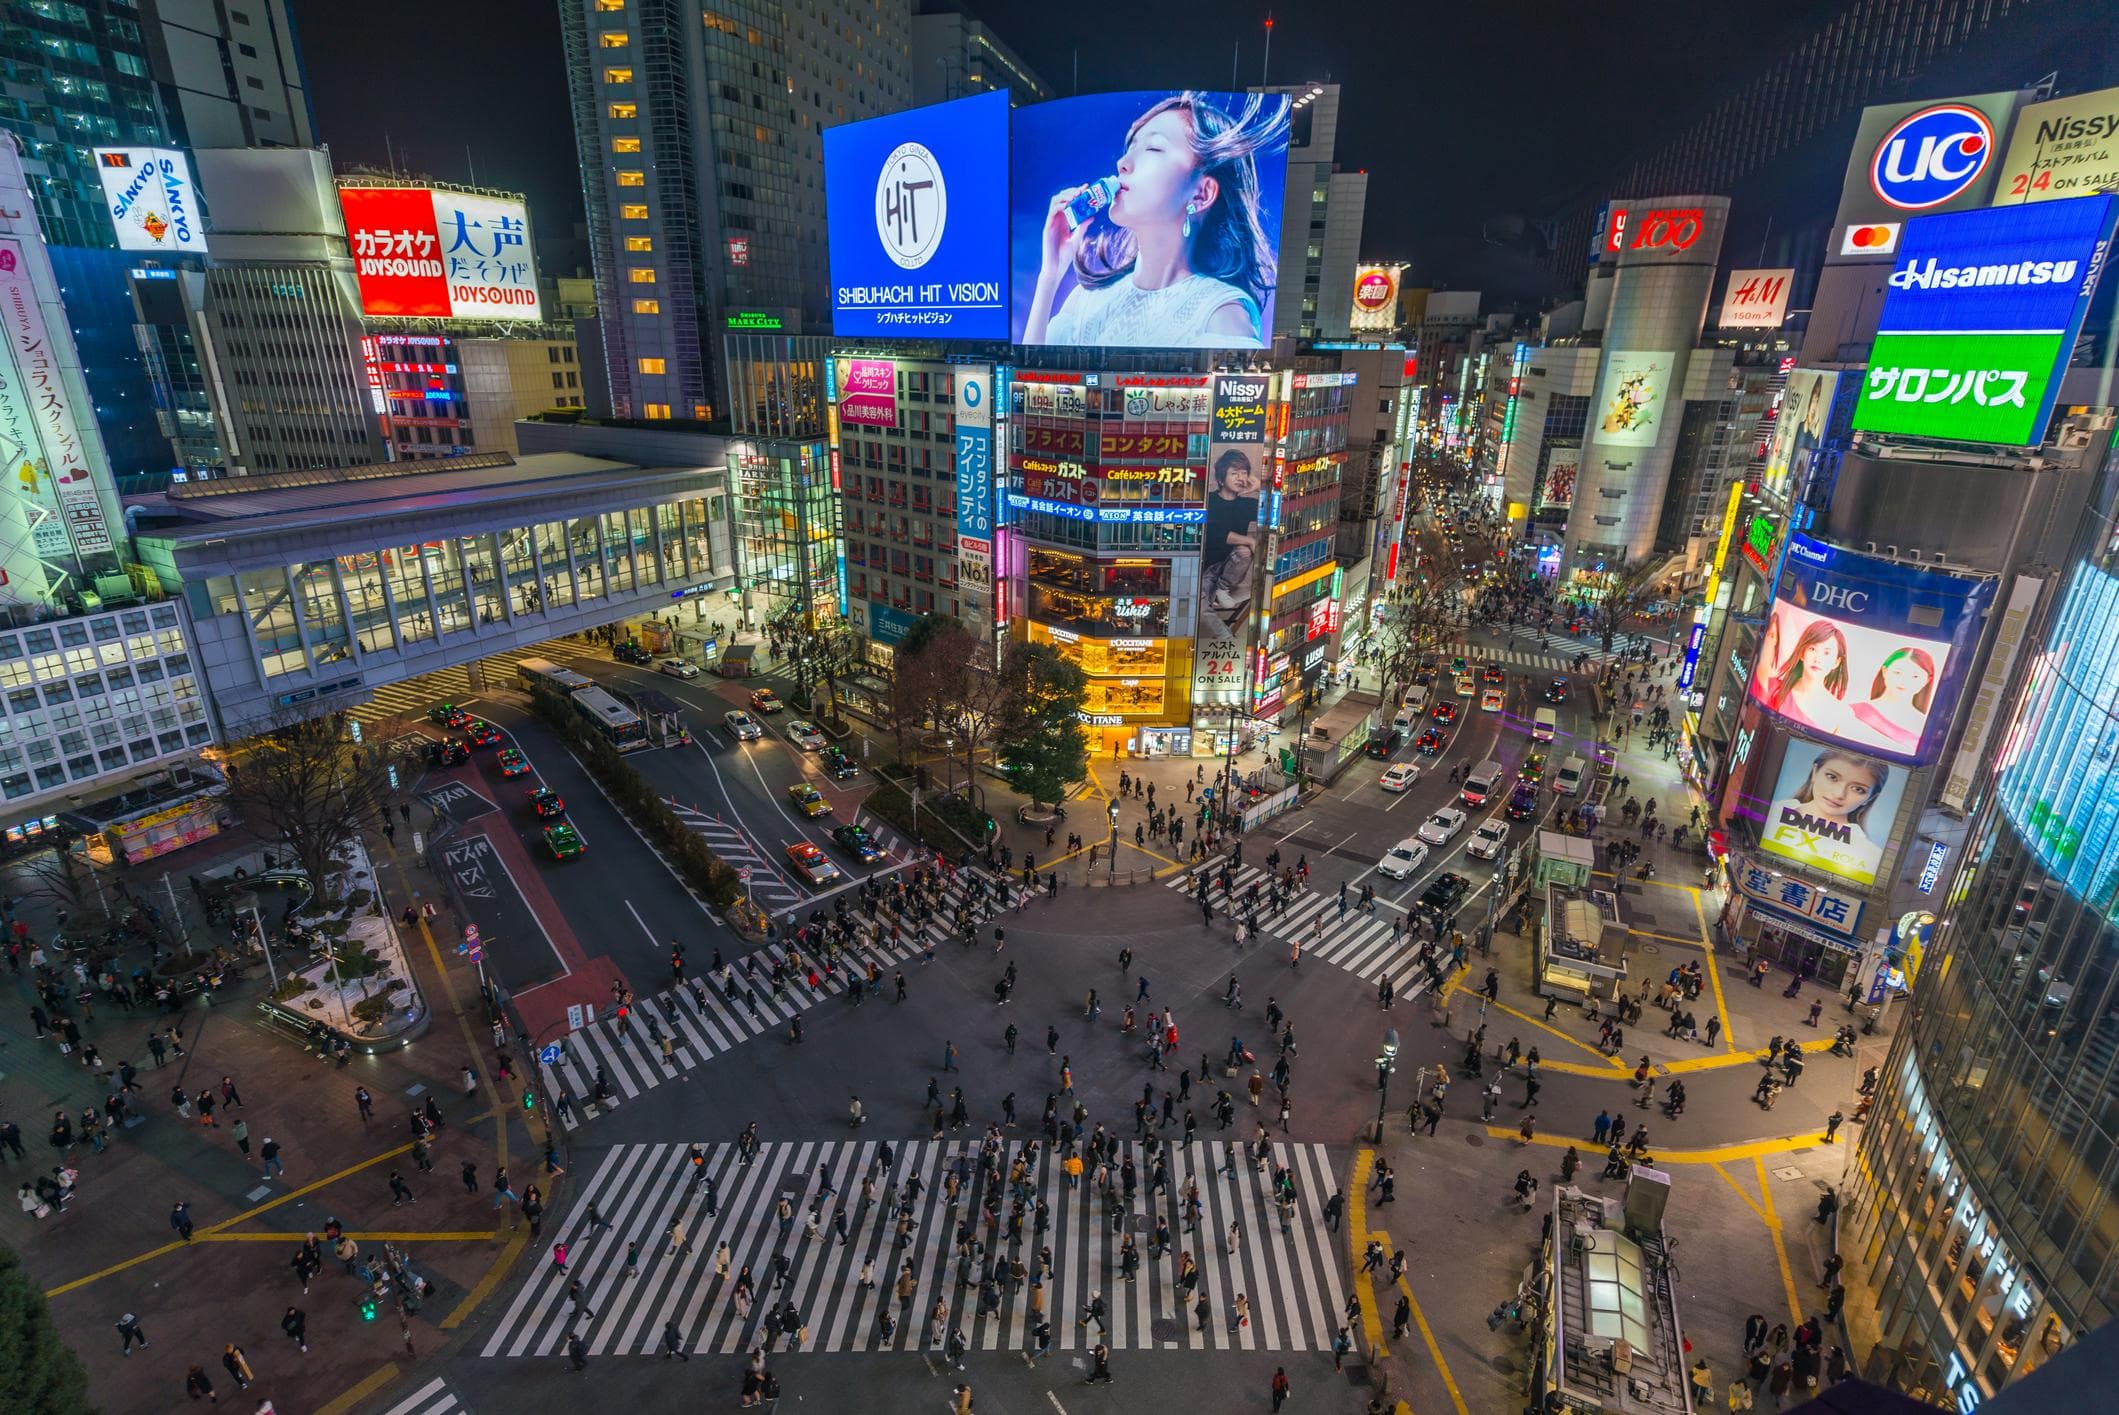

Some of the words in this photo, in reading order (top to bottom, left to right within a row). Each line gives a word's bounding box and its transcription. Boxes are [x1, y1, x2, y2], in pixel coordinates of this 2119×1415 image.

[2035, 115, 2119, 144] Nissy
[886, 146, 907, 167] TOKYO
[909, 144, 930, 161] GINZA
[1885, 131, 1985, 183] UC
[113, 161, 155, 219] SANKYO
[2054, 178, 2079, 190] ON
[2082, 171, 2119, 187] SALE
[159, 158, 191, 242] SANKYO
[354, 228, 436, 257] カラオケ
[441, 210, 524, 257] 大声
[360, 258, 443, 277] JOYSOUND
[450, 257, 529, 285] だそうぜ
[1888, 258, 2078, 290] Hisamitsu
[2079, 240, 2107, 297] サロンパス
[453, 285, 535, 305] JOYSOUND
[838, 287, 914, 306] SHIBUHACHI
[919, 285, 943, 303] HIT
[949, 282, 999, 303] VISION
[1731, 276, 1786, 305] H&M
[9, 286, 32, 331] SHIBUYA
[876, 311, 953, 325] シブハチヒットビジョン
[861, 366, 892, 378] 品川スキン
[861, 379, 889, 390] クリニック
[1220, 380, 1265, 399] Nissy
[1868, 366, 2029, 408] サロンパス
[1012, 391, 1025, 403] 9F
[1154, 394, 1208, 412] しゃぶ葉
[846, 404, 894, 421] 品川美容外科
[1215, 404, 1265, 419] 4大ドーム
[1224, 417, 1256, 429] ツアー
[1026, 430, 1083, 449] プライス
[1101, 436, 1185, 454] コンタクト
[1057, 461, 1088, 480] ガスト
[1157, 467, 1198, 483] ガスト
[960, 435, 974, 529] アイシティ
[976, 437, 988, 531] コンタクトの
[1011, 475, 1025, 488] 7F
[1043, 478, 1078, 500] ガスト
[1031, 500, 1082, 517] 英会話イーオン
[1132, 510, 1205, 522] 英会話イーオン
[1799, 546, 1828, 562] Channel
[1811, 581, 1869, 613] DHC
[1209, 640, 1236, 650] ベスト
[1201, 650, 1241, 660] アルバム
[1206, 659, 1234, 675] 2.4
[1198, 676, 1215, 684] ON
[1217, 675, 1241, 684] SALE
[1779, 806, 1852, 845] DMM
[1773, 825, 1823, 855] FX
